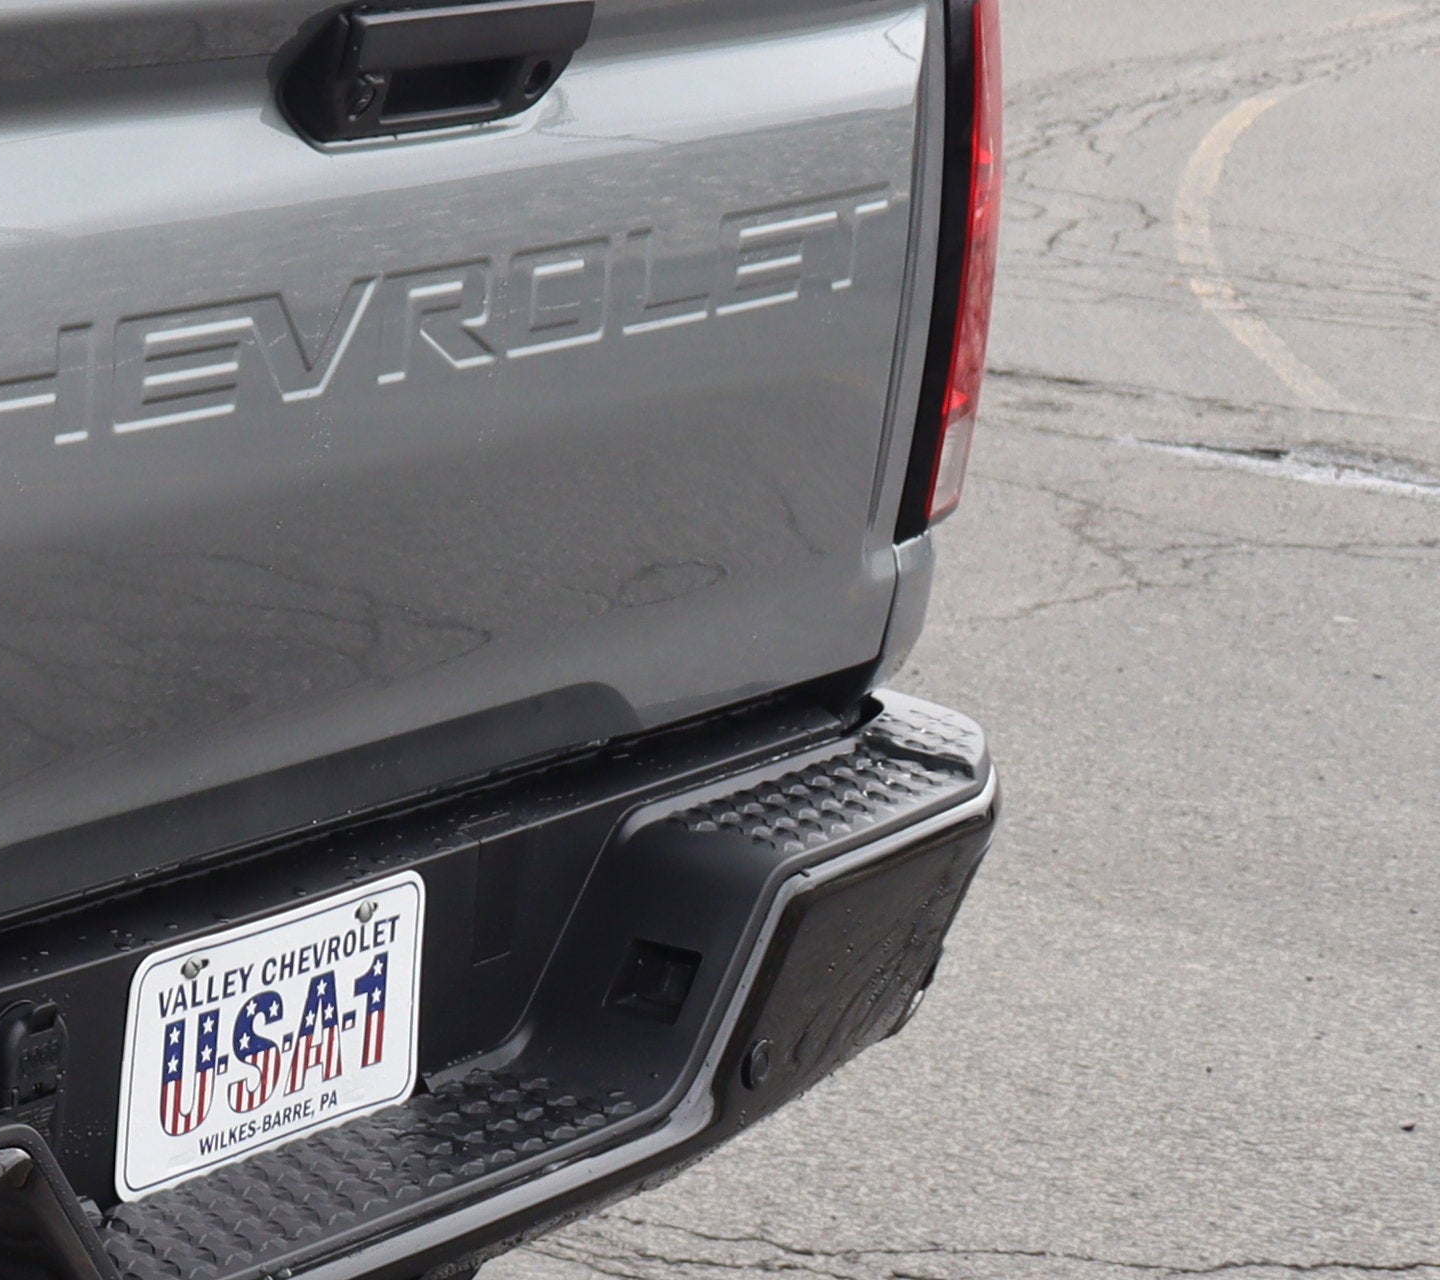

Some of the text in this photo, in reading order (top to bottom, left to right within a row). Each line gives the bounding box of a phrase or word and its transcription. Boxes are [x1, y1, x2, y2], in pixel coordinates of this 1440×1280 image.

[158, 915, 401, 1018] VALLEY CHEVROLET
[199, 1090, 338, 1156] WILKES-BARRE, PA
